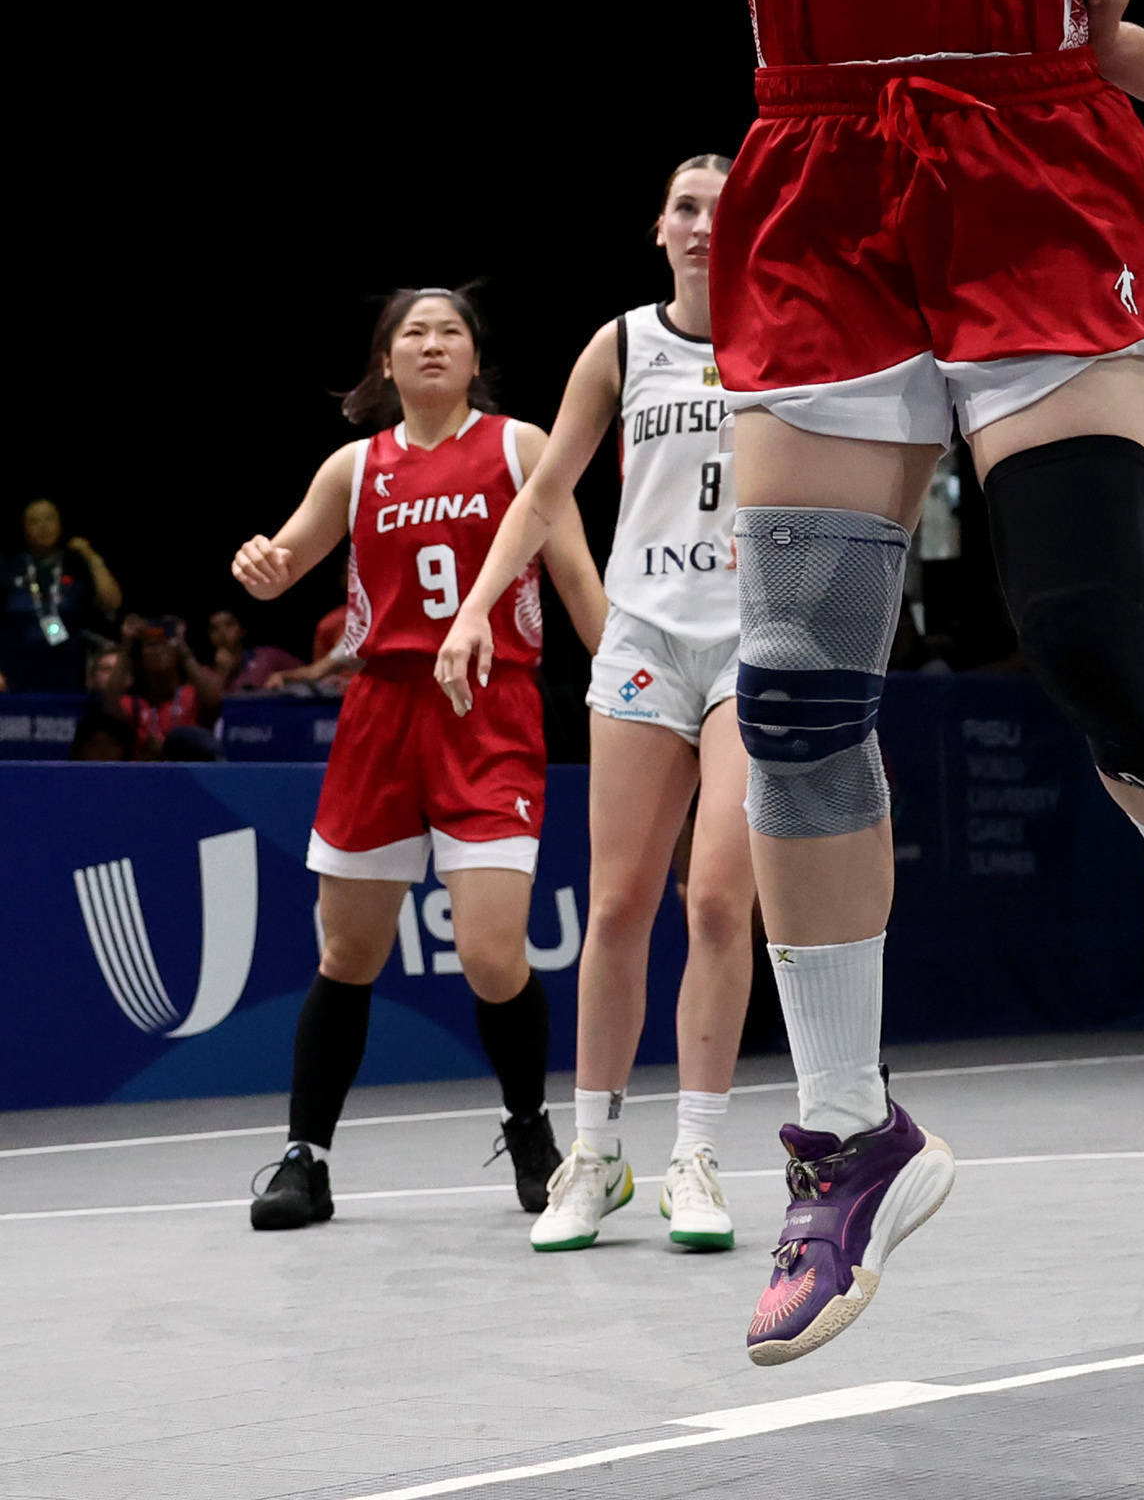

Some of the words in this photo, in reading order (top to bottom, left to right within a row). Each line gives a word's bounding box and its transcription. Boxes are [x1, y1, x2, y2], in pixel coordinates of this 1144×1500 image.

[699, 462, 721, 511] 8
[376, 493, 489, 534] CHINA
[416, 543, 460, 620] 9
[643, 541, 717, 576] ING
[314, 885, 581, 976] ISU
